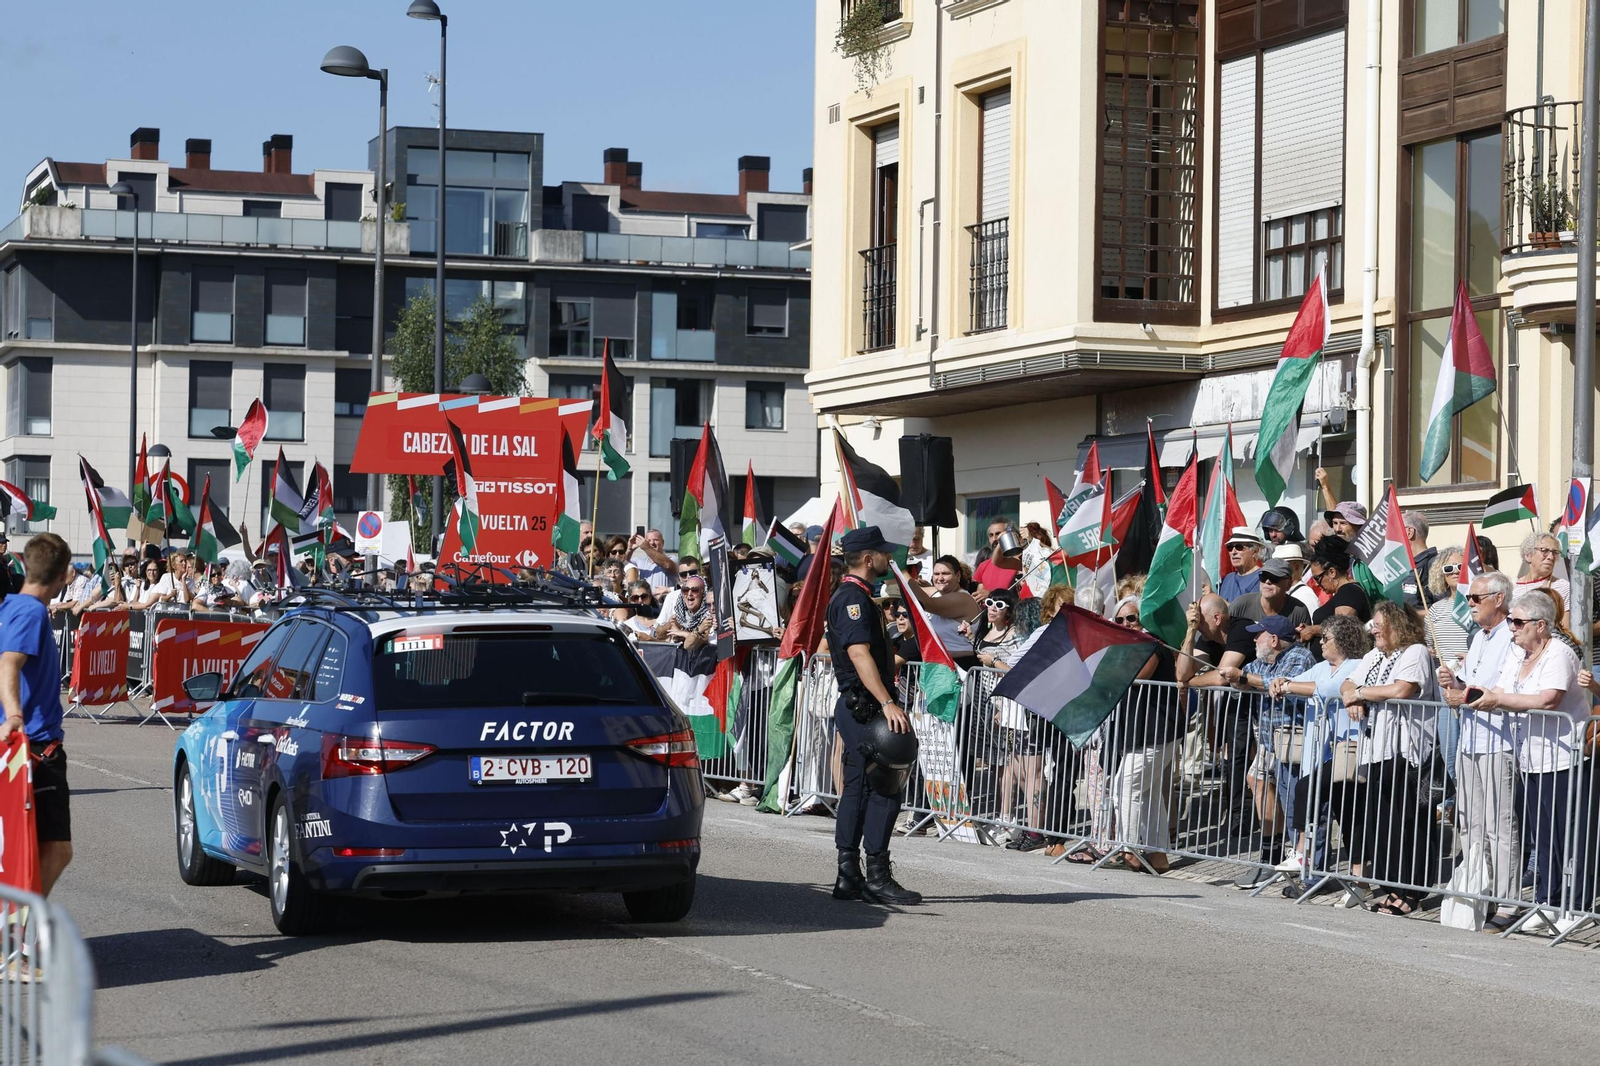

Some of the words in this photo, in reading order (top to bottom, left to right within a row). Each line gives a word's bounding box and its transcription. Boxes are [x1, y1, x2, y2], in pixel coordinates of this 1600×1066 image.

[403, 431, 467, 454] CABEZ
[471, 434, 489, 456] DE
[492, 434, 509, 456] LA
[513, 435, 539, 457] SAL
[497, 481, 557, 495] TISSOT
[480, 514, 529, 531] VUELTA
[531, 516, 547, 531] 25
[401, 640, 426, 650] 1111
[88, 650, 97, 676] LA
[97, 648, 117, 675] VUELTA
[480, 720, 575, 741] FACTOR
[473, 770, 480, 779] B
[294, 819, 333, 839] FANTINI
